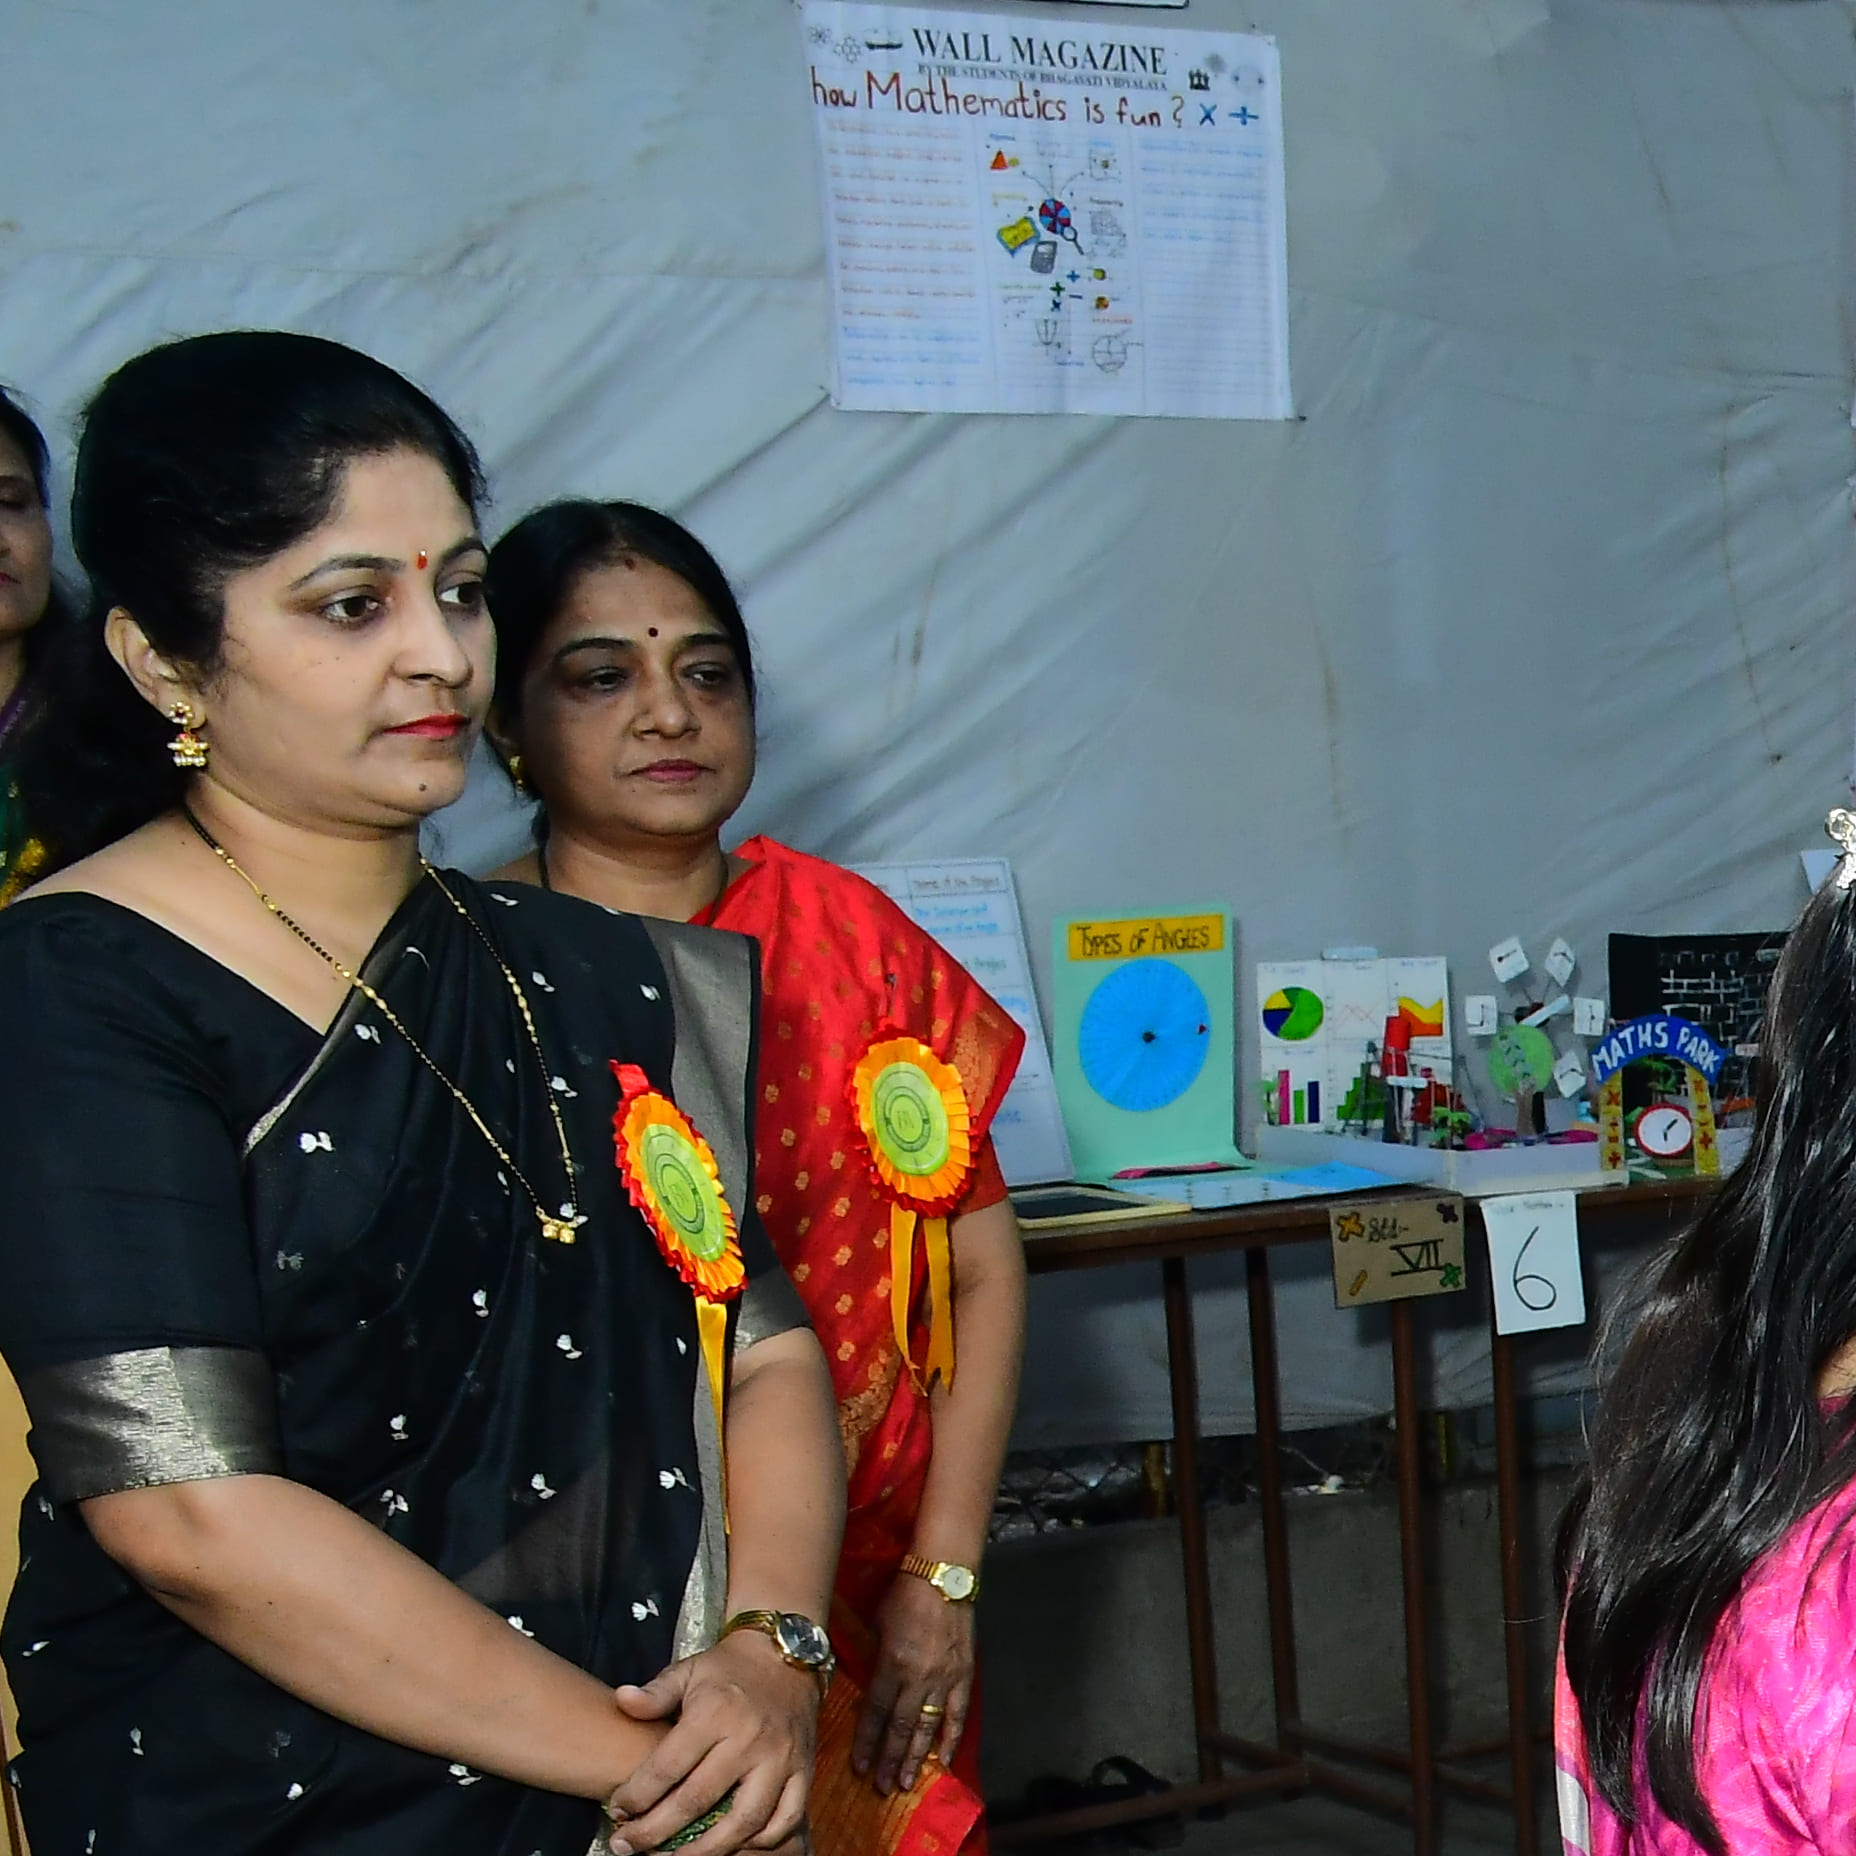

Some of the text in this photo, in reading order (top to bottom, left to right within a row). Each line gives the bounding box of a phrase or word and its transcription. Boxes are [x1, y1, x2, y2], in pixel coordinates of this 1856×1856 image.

[912, 28, 1169, 76] WALL MAGAZINE
[810, 65, 857, 107] how
[867, 69, 1068, 122] Mathematics
[1084, 91, 1105, 124] is
[1591, 1021, 1720, 1081] MATHS PARK
[1390, 1238, 1446, 1277] VII
[1513, 1225, 1557, 1311] 6
